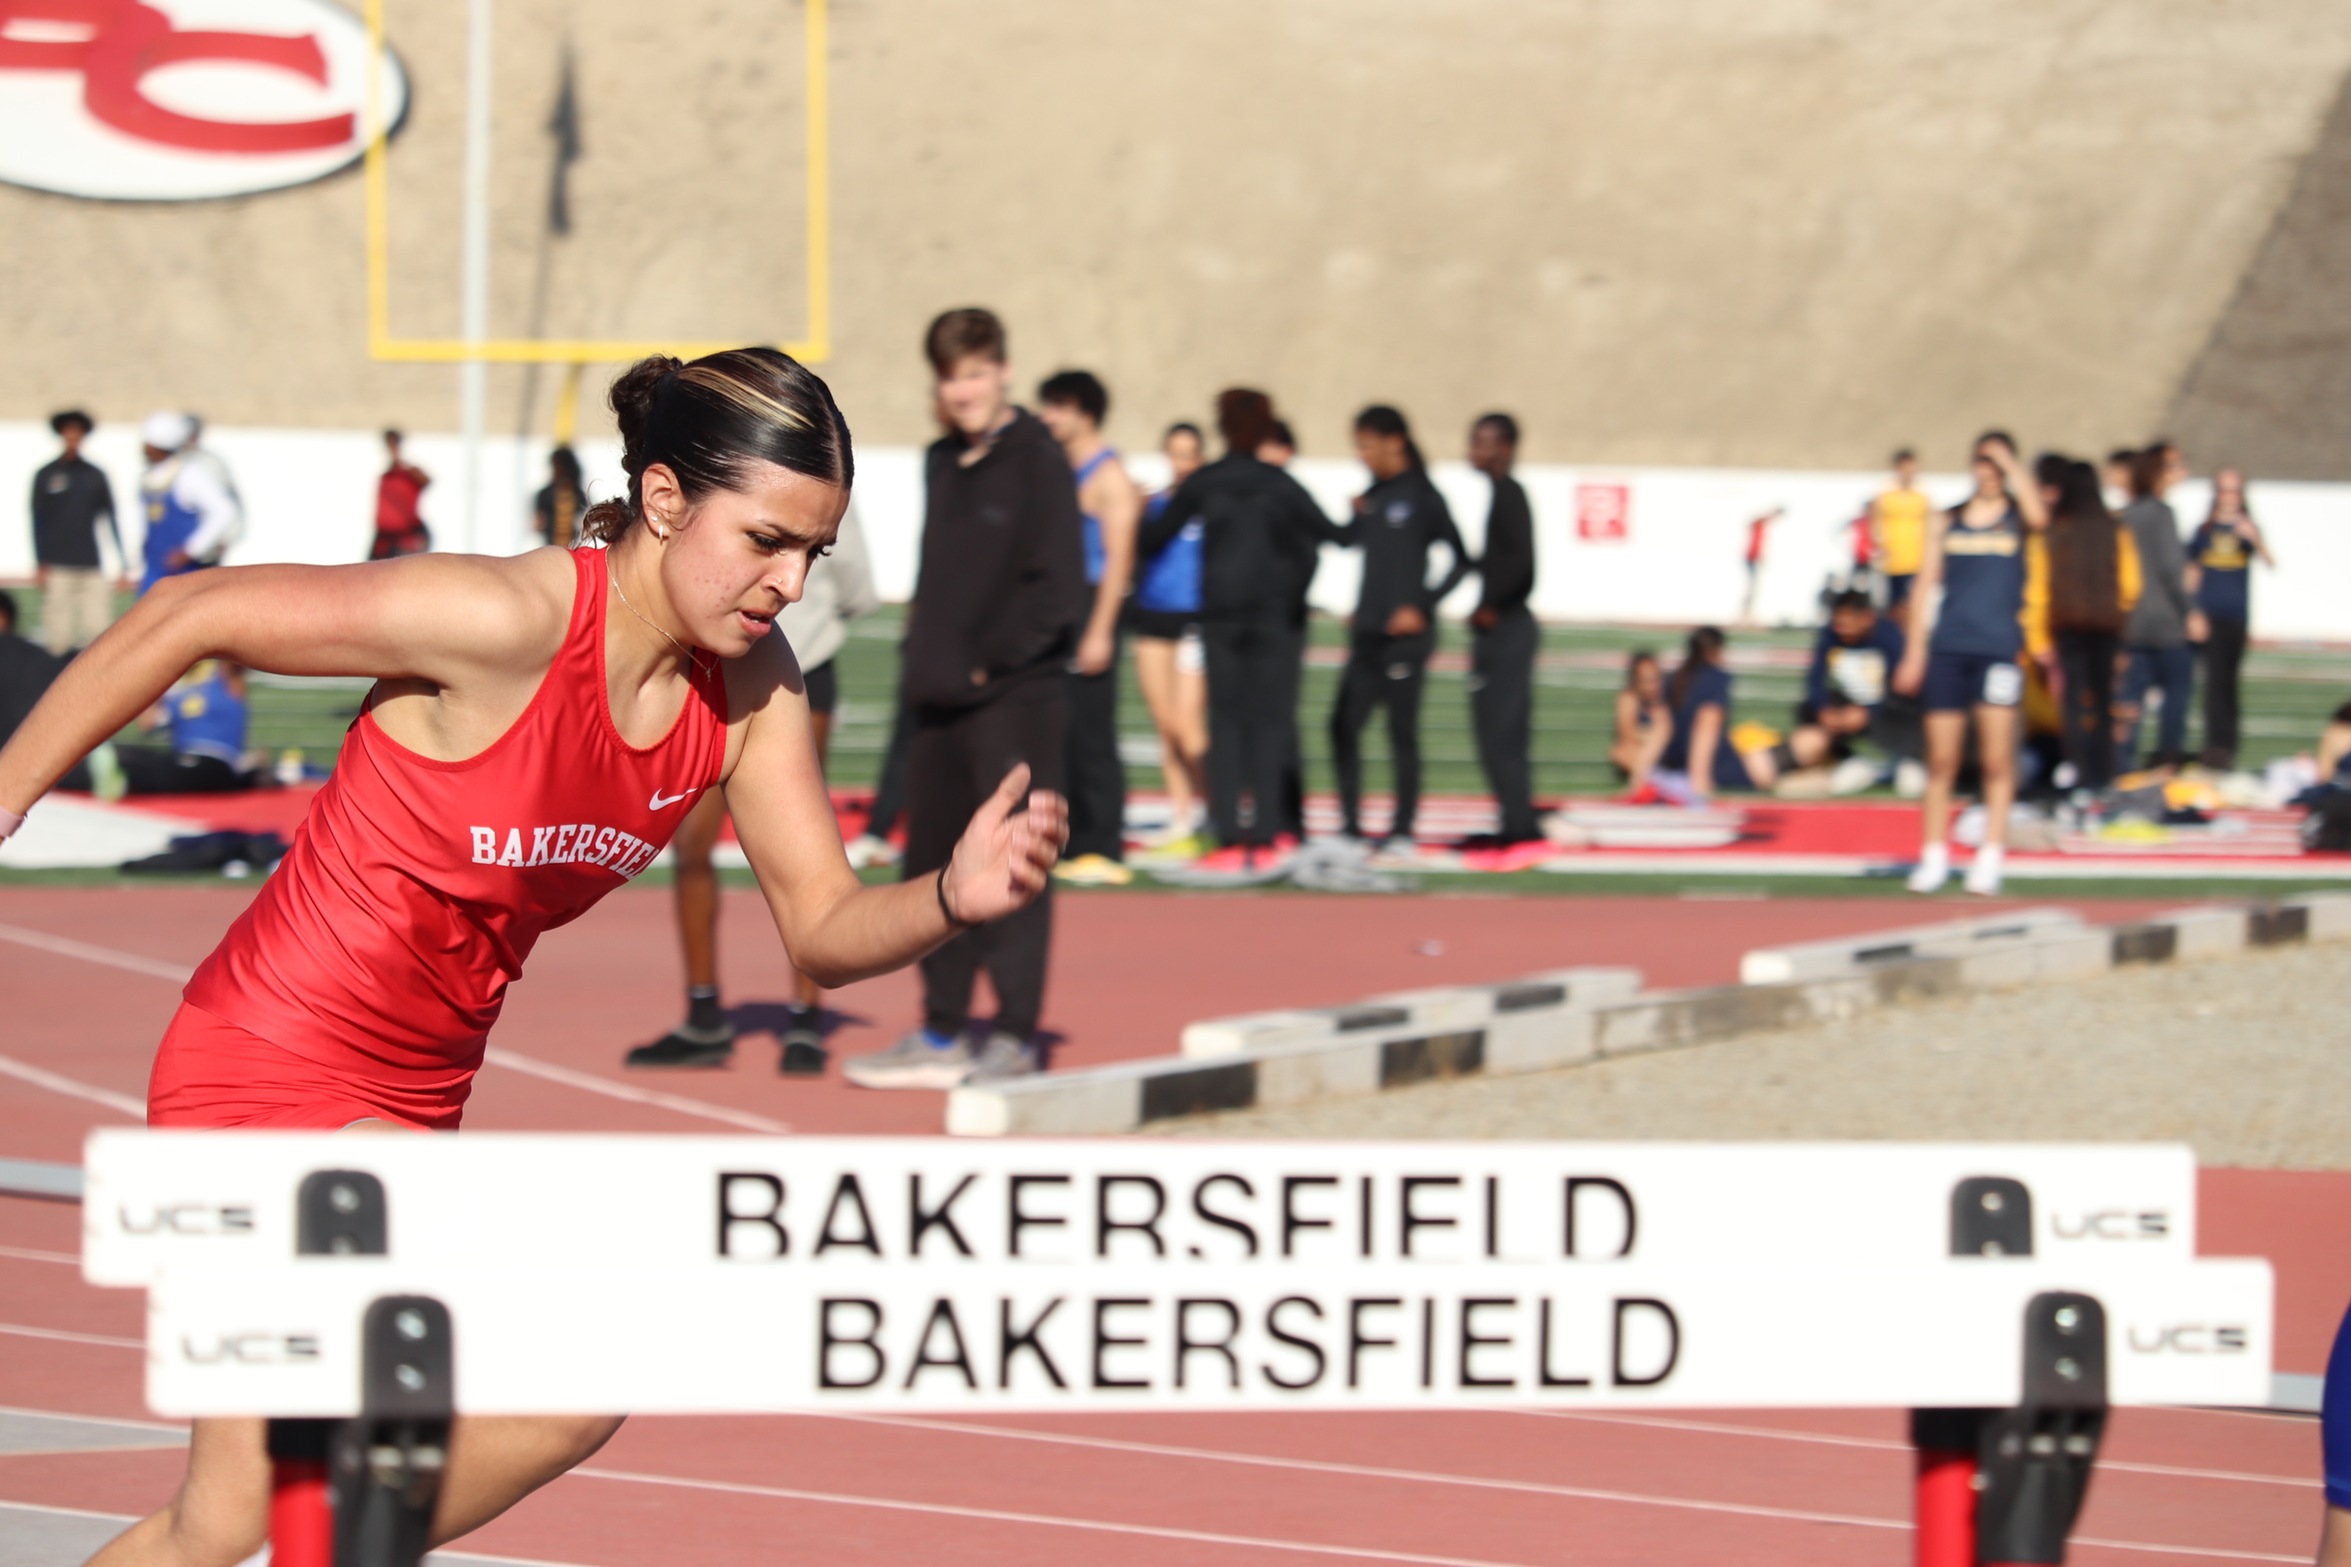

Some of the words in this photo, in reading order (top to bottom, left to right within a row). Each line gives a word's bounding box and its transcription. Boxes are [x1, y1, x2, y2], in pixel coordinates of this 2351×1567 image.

[0, 0, 355, 155] C
[119, 1206, 256, 1234] UCS
[715, 1171, 1639, 1257] BAKERSFIELD
[2052, 1210, 2170, 1239] UCS
[183, 1333, 321, 1363] UCS
[816, 1294, 1682, 1392] BAKERSFIELD
[2128, 1325, 2248, 1353] UCS
